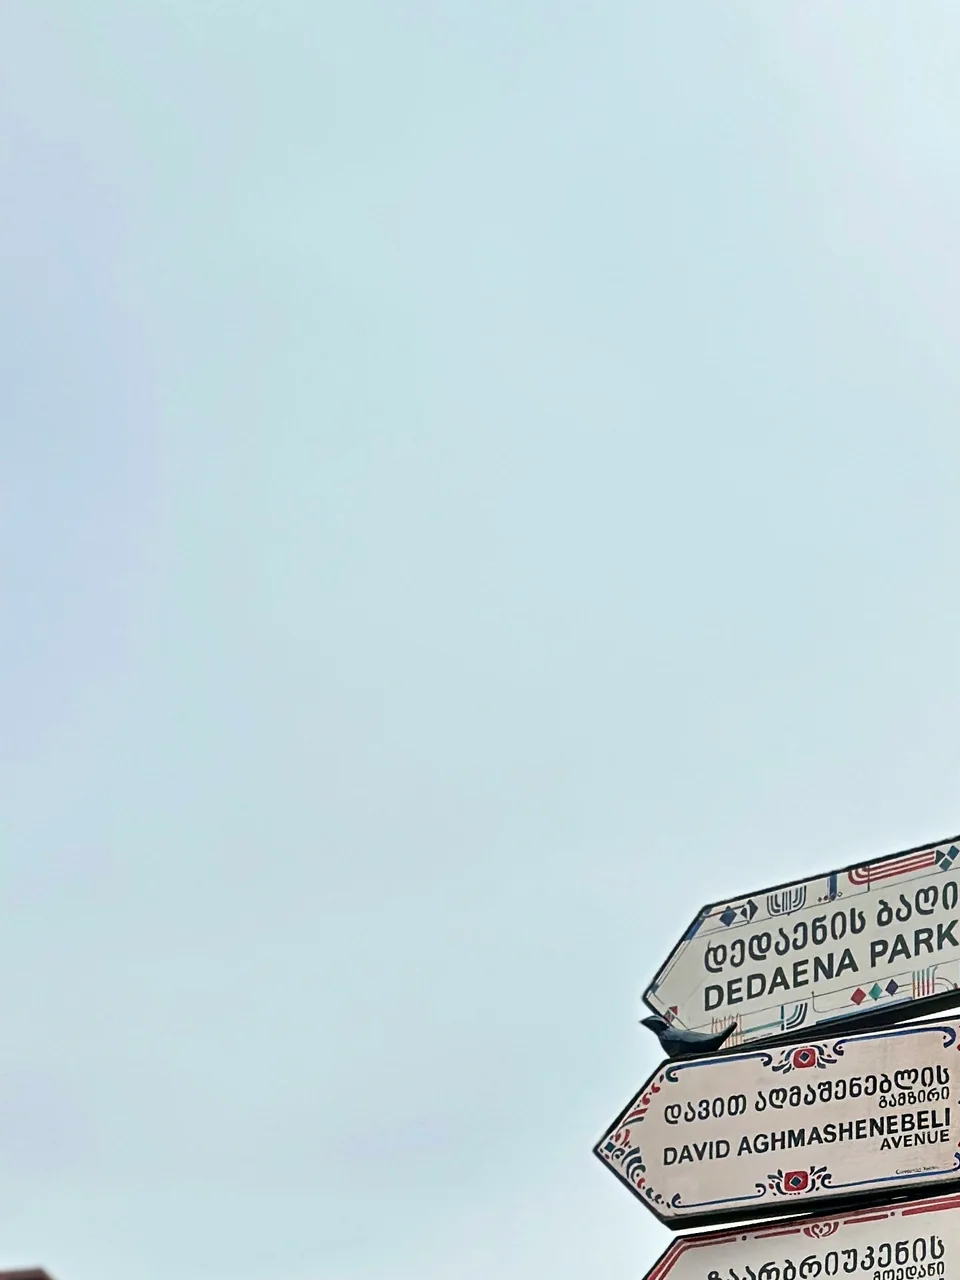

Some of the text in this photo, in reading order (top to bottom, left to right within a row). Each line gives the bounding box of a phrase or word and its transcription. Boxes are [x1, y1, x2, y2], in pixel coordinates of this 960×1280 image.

[704, 881, 958, 973] დედაენის ბაღი
[704, 919, 960, 1012] DEDAENA PARK
[664, 1064, 950, 1125] დავით აღმაშენებლის
[878, 1086, 950, 1109] გამზირი
[663, 1107, 951, 1165] DAVID AGHMASHENEBELI
[880, 1128, 950, 1151] AVENUE
